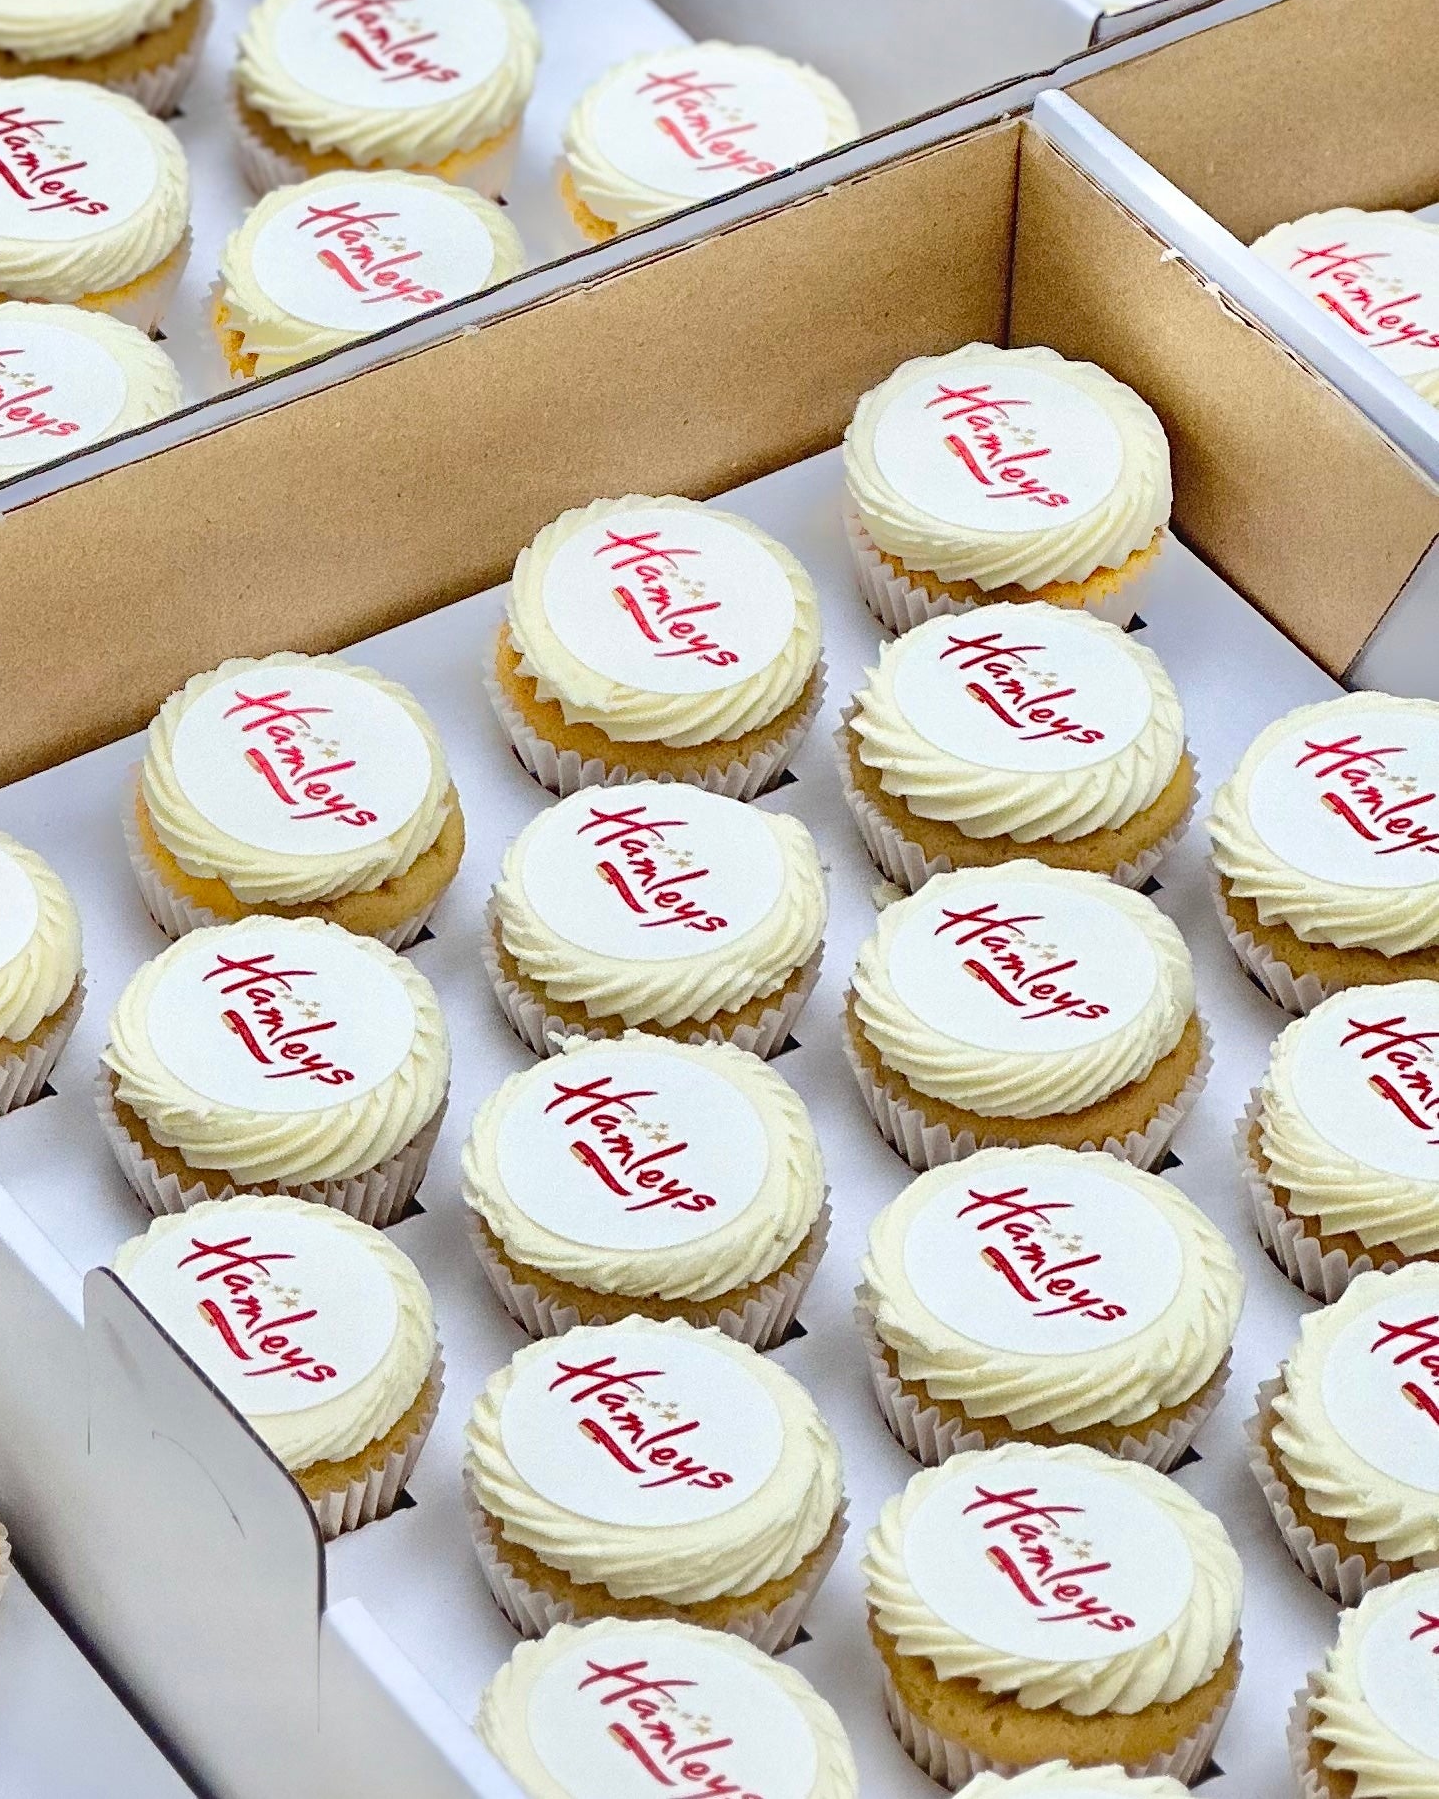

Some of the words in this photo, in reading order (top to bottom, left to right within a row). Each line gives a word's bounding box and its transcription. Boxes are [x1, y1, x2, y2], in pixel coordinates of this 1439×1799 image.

[641, 71, 776, 181] Hamleys
[300, 202, 451, 310] Hamleys
[928, 384, 1070, 509] Hamleys
[595, 530, 740, 668] Hamleys
[940, 633, 1105, 745] Hamleys
[224, 689, 378, 828] Hamleys
[578, 805, 729, 934] Hamleys
[203, 954, 355, 1087] Hamleys
[935, 903, 1110, 1021] Hamleys
[544, 1076, 717, 1214] Hamleys
[178, 1235, 338, 1384] Hamleys
[957, 1186, 1128, 1323] Hamleys
[548, 1355, 734, 1491] Hamleys
[963, 1486, 1136, 1633] Hamleys
[579, 1660, 764, 1799] Hamley
